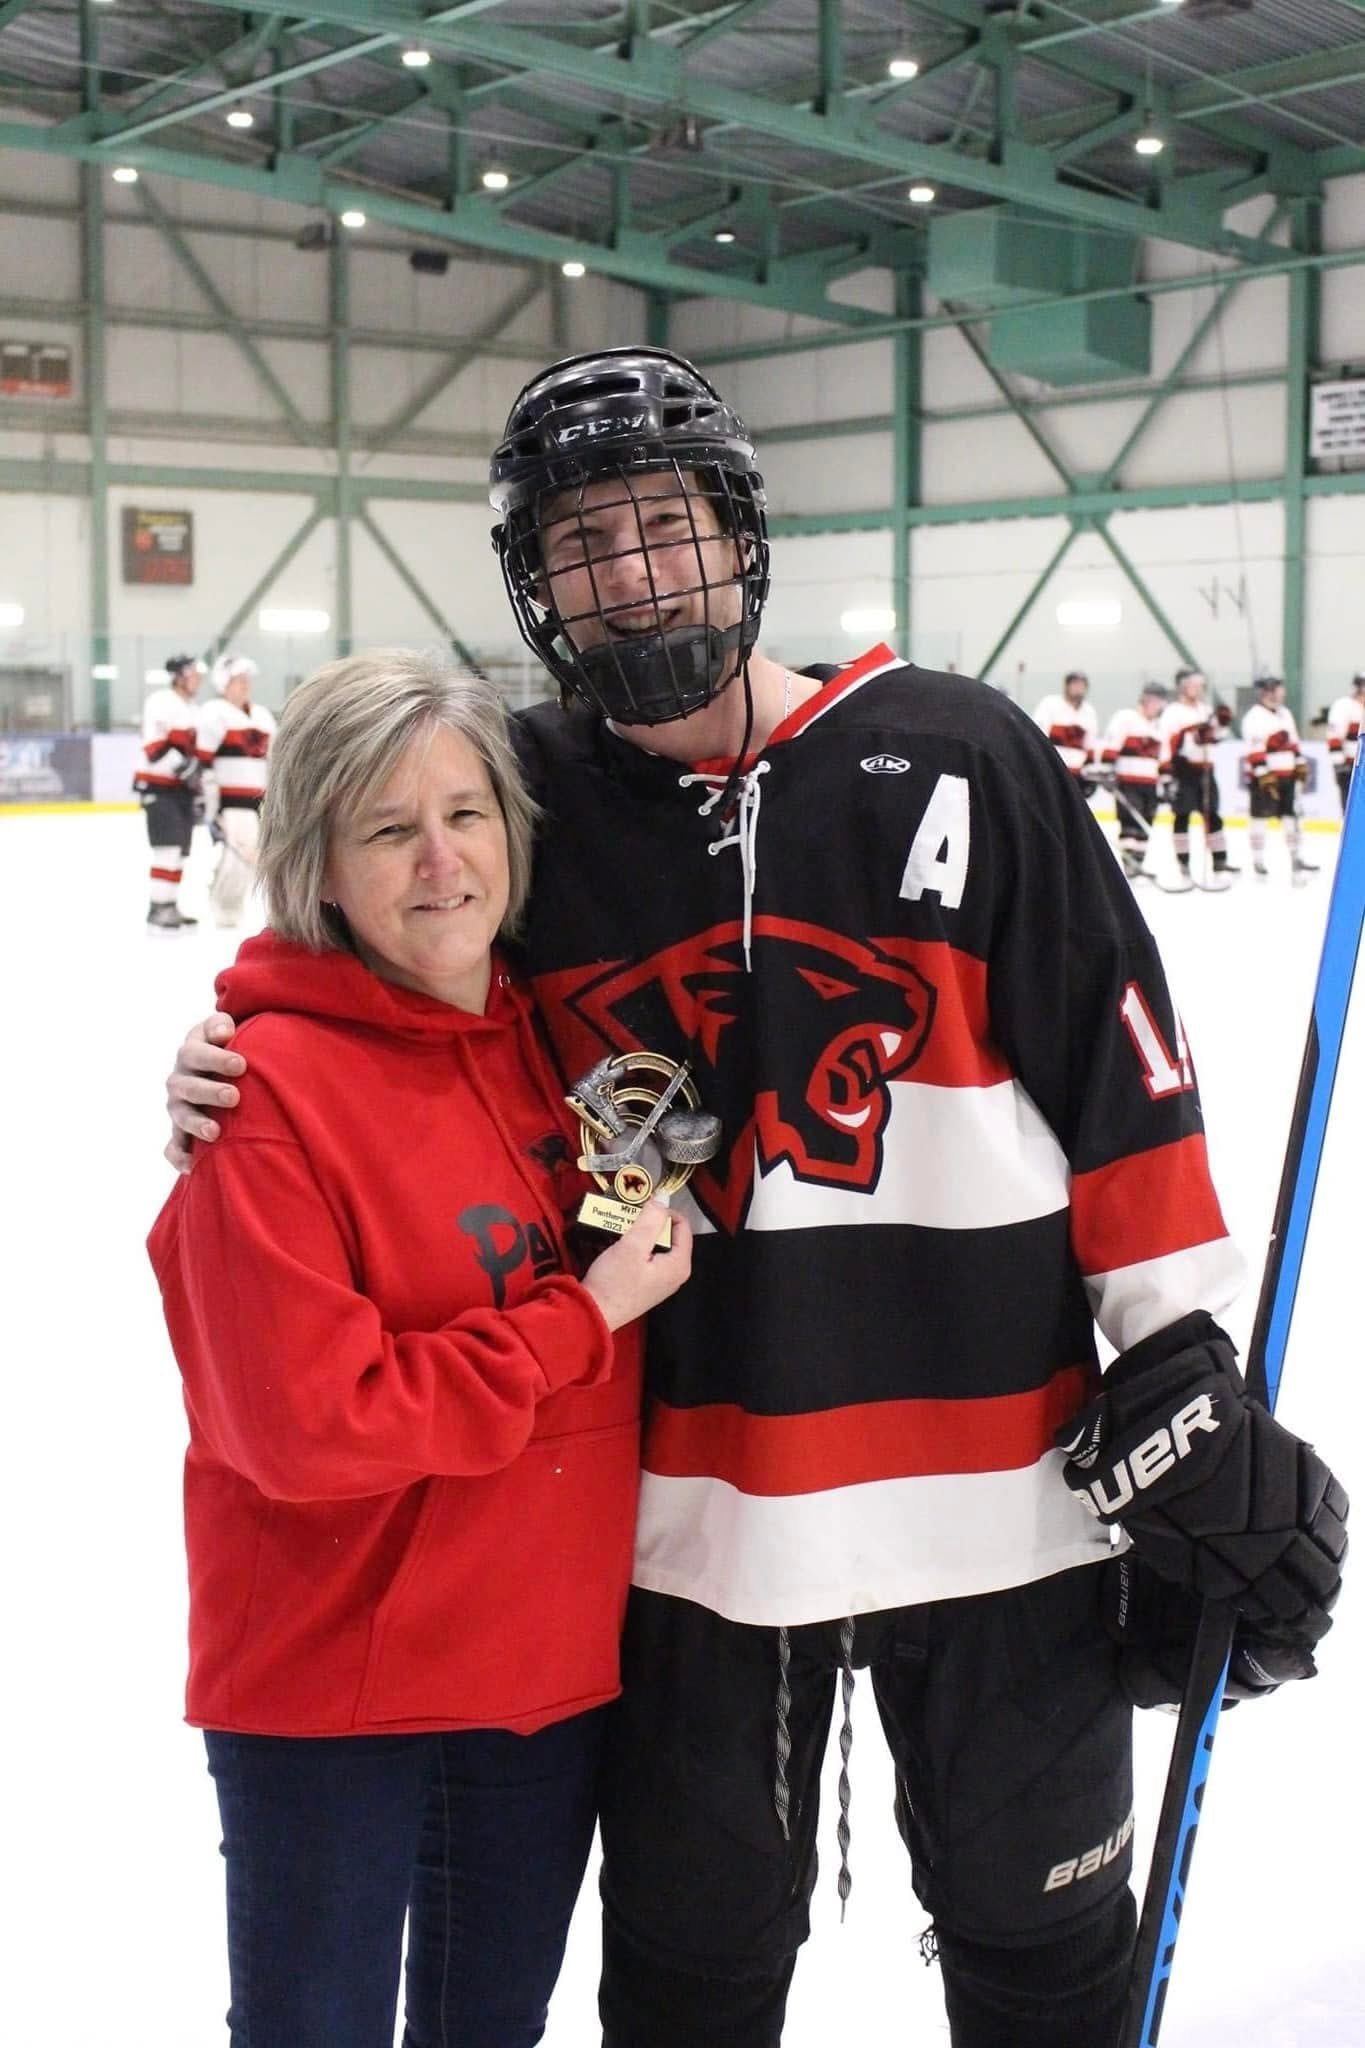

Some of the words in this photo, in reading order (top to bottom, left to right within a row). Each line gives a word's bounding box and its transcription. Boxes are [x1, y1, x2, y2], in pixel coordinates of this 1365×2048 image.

[559, 414, 645, 442] CCM
[899, 773, 970, 910] A
[592, 1206, 625, 1222] Panthers
[620, 1204, 637, 1215] MVP
[602, 1219, 623, 1232] 2023
[1042, 1809, 1135, 1893] BAUE
